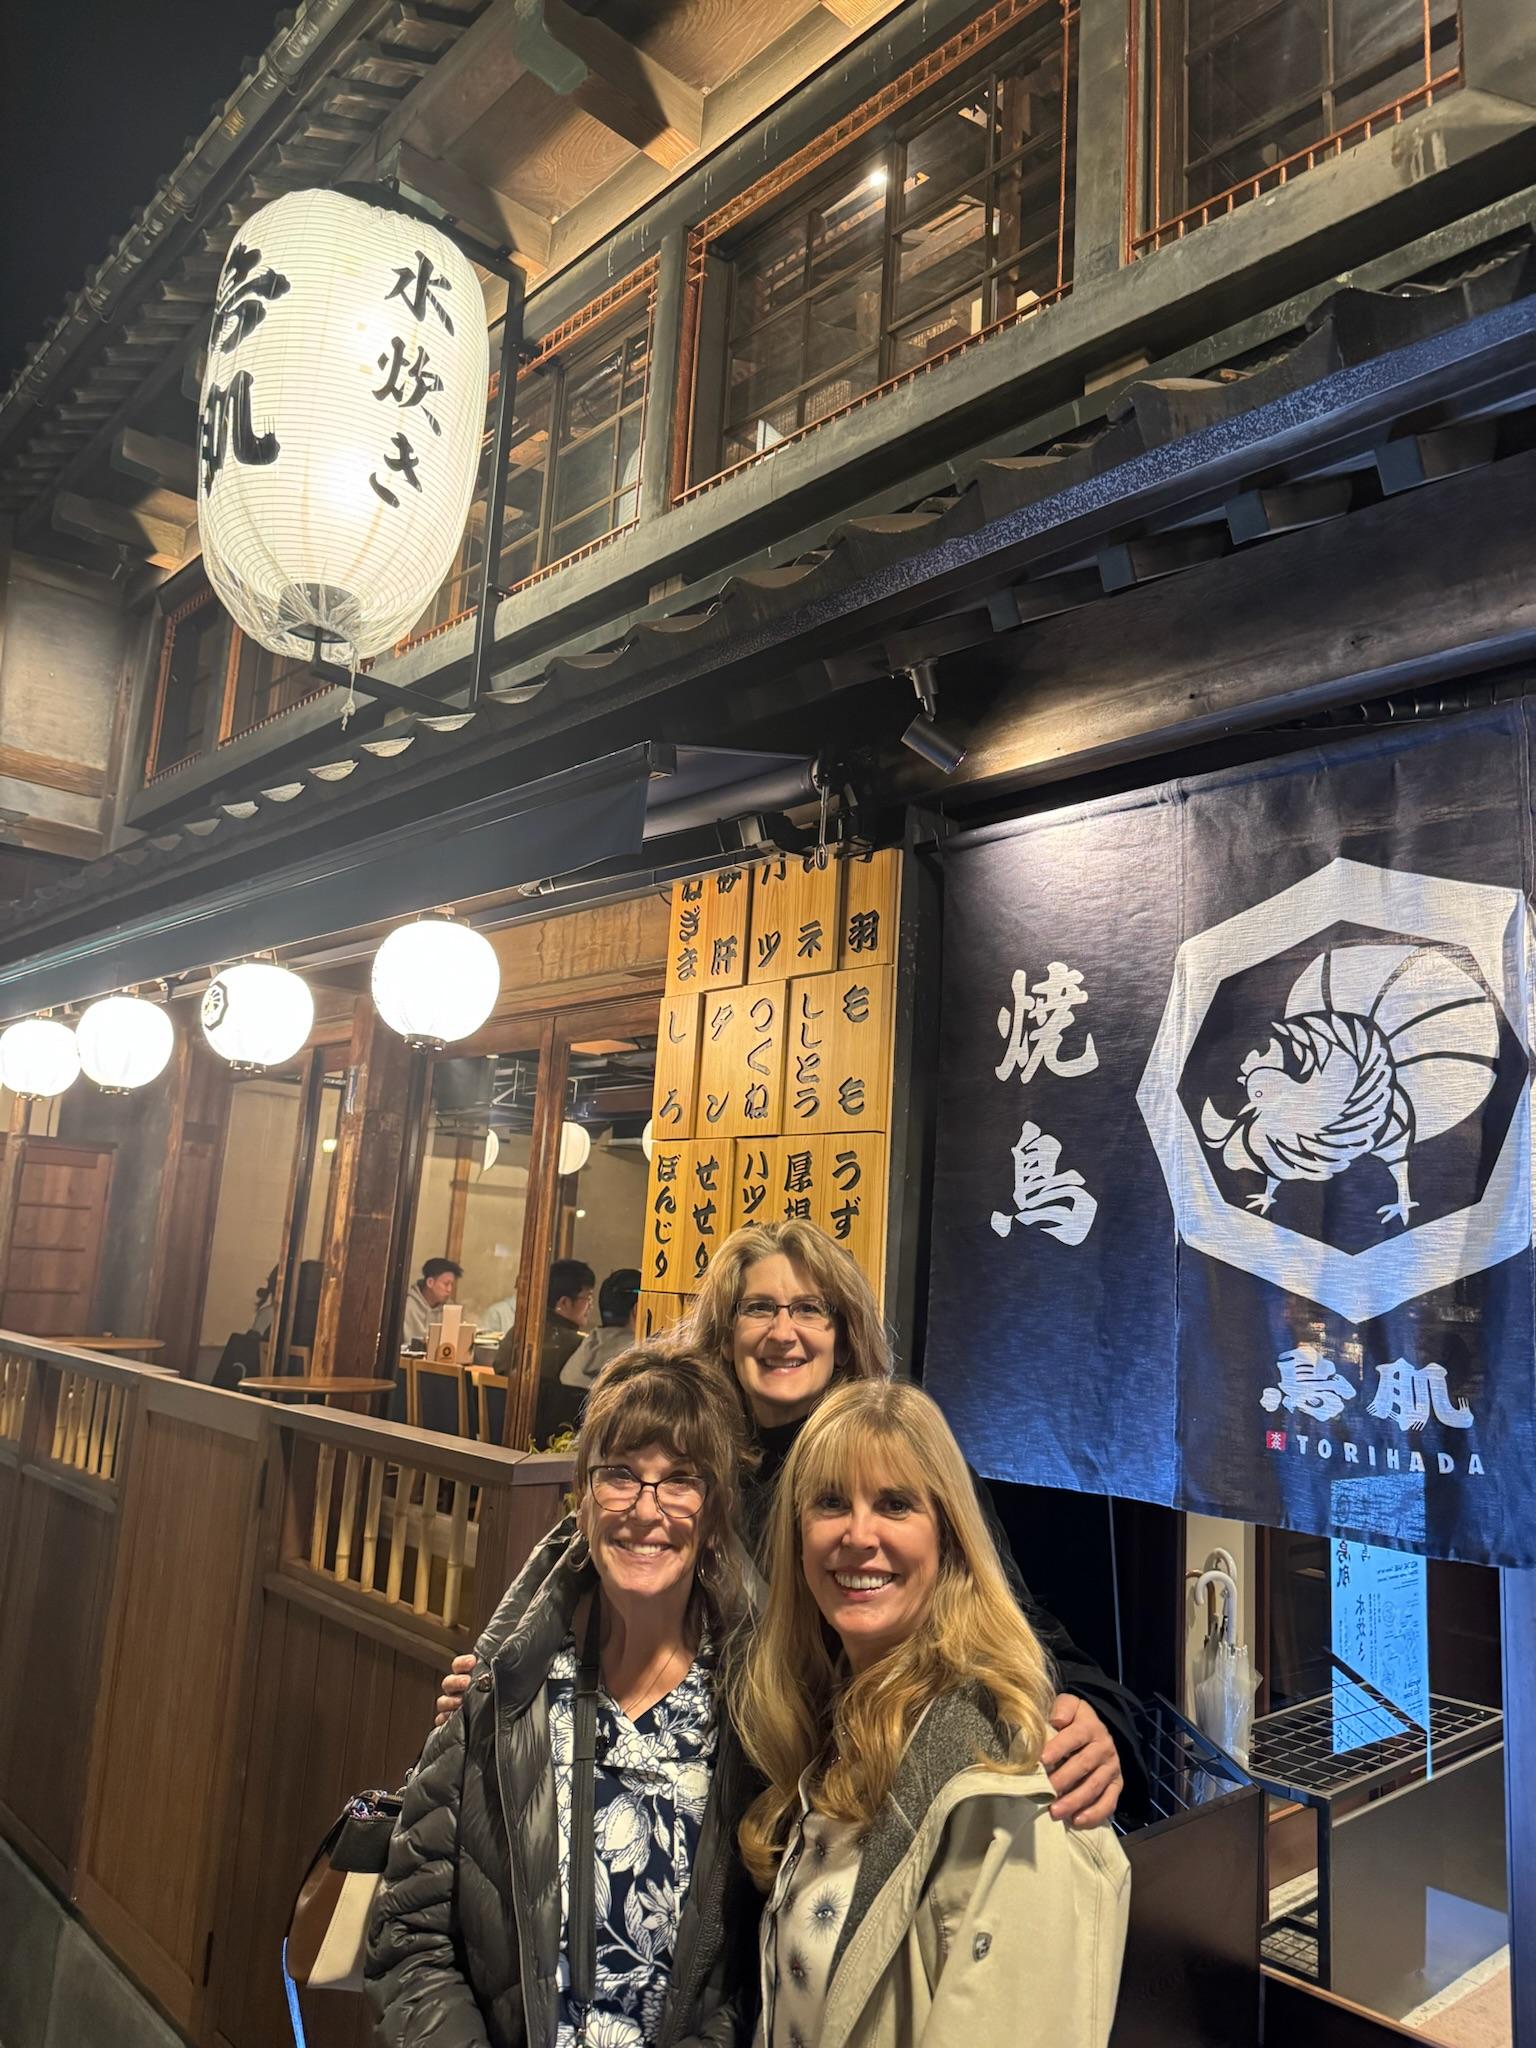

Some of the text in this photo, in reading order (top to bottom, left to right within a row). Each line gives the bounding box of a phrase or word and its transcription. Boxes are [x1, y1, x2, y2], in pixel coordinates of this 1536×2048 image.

[368, 250, 455, 508] 水炊き
[676, 880, 703, 981] ねぎま
[848, 851, 880, 954] 羽
[659, 1011, 687, 1124] しろ
[706, 1004, 735, 1123] タン
[744, 997, 775, 1119] つくね
[793, 993, 824, 1118] ししとう
[990, 961, 1099, 1247] 焼鳥
[655, 1154, 682, 1278] ぼんじり
[693, 1155, 720, 1279] せせり
[742, 1151, 769, 1228] ハツ
[830, 1150, 862, 1240] うず
[1259, 1350, 1474, 1431] 鳥肌
[1296, 1434, 1485, 1475] TORIHADA
